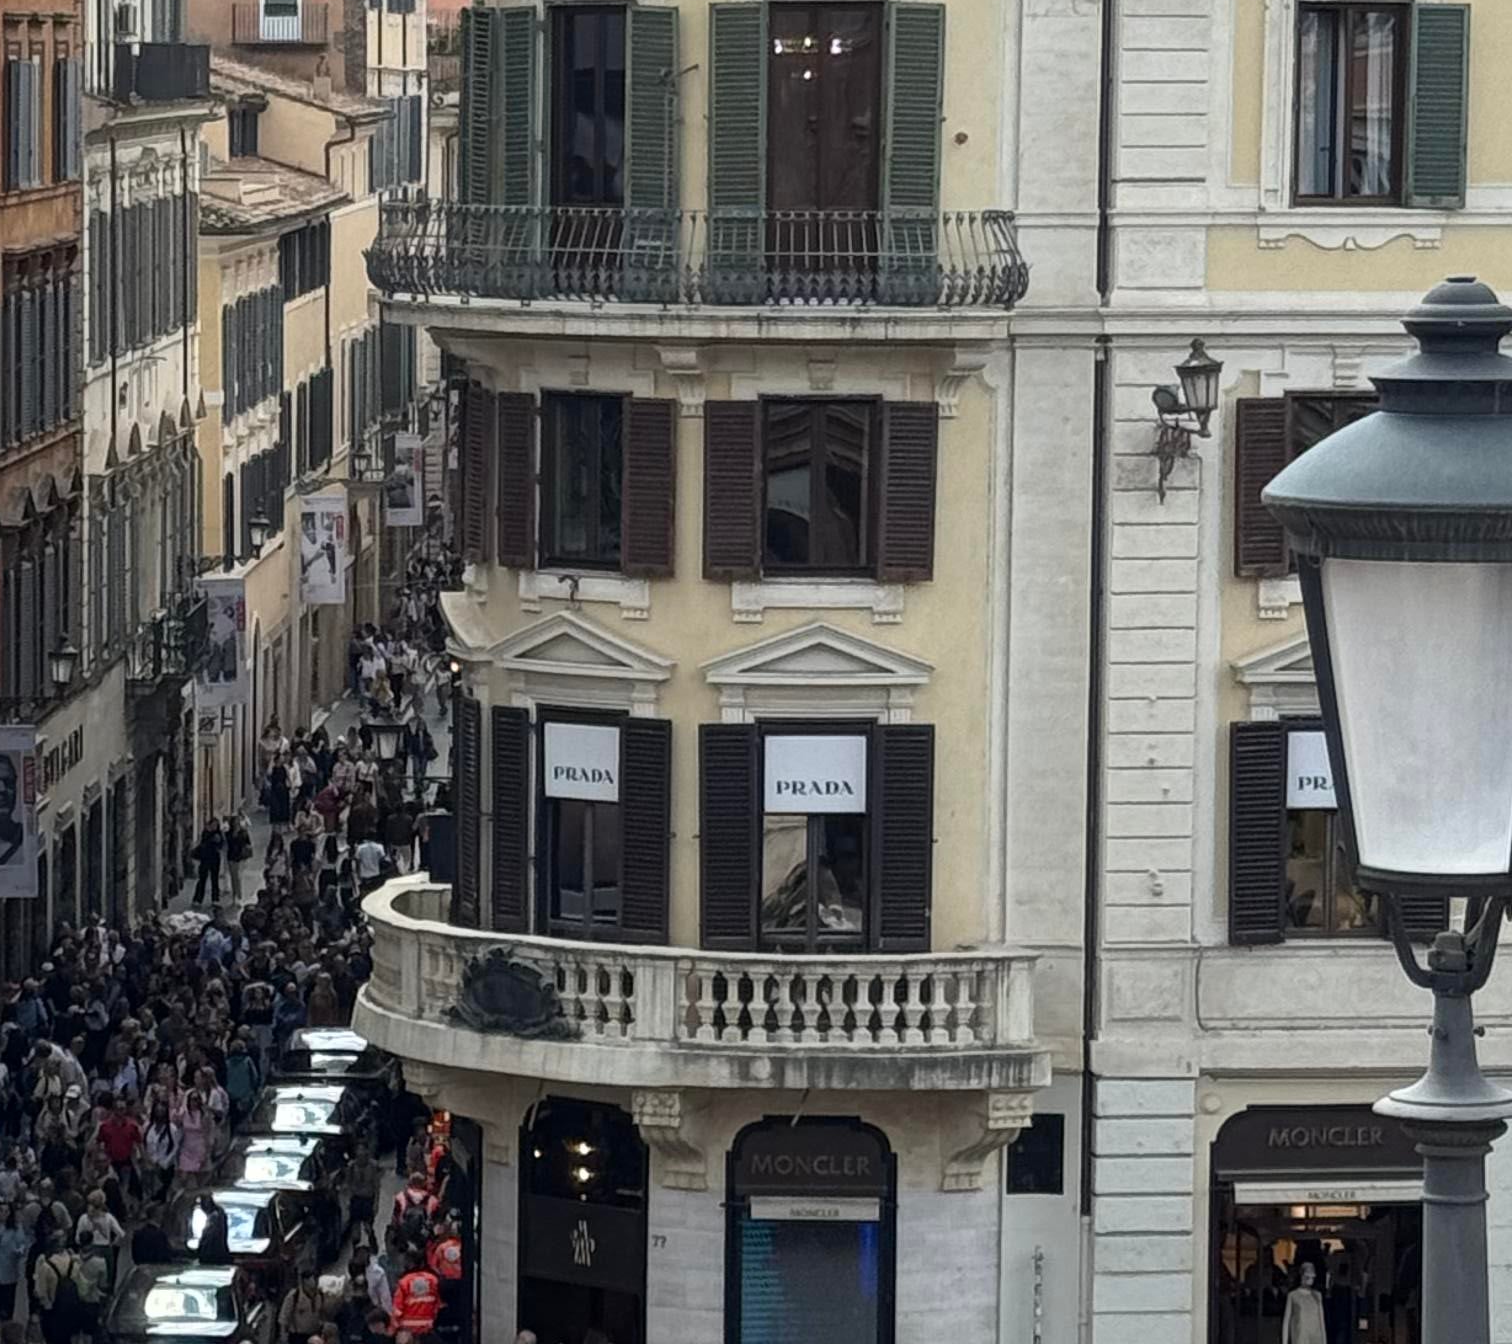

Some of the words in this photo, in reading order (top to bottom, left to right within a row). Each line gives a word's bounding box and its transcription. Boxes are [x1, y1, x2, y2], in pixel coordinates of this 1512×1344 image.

[554, 766, 614, 784] PRADA
[776, 780, 854, 796] PRADA
[1268, 1127, 1383, 1147] MONCLER
[751, 1154, 872, 1176] MONCLER
